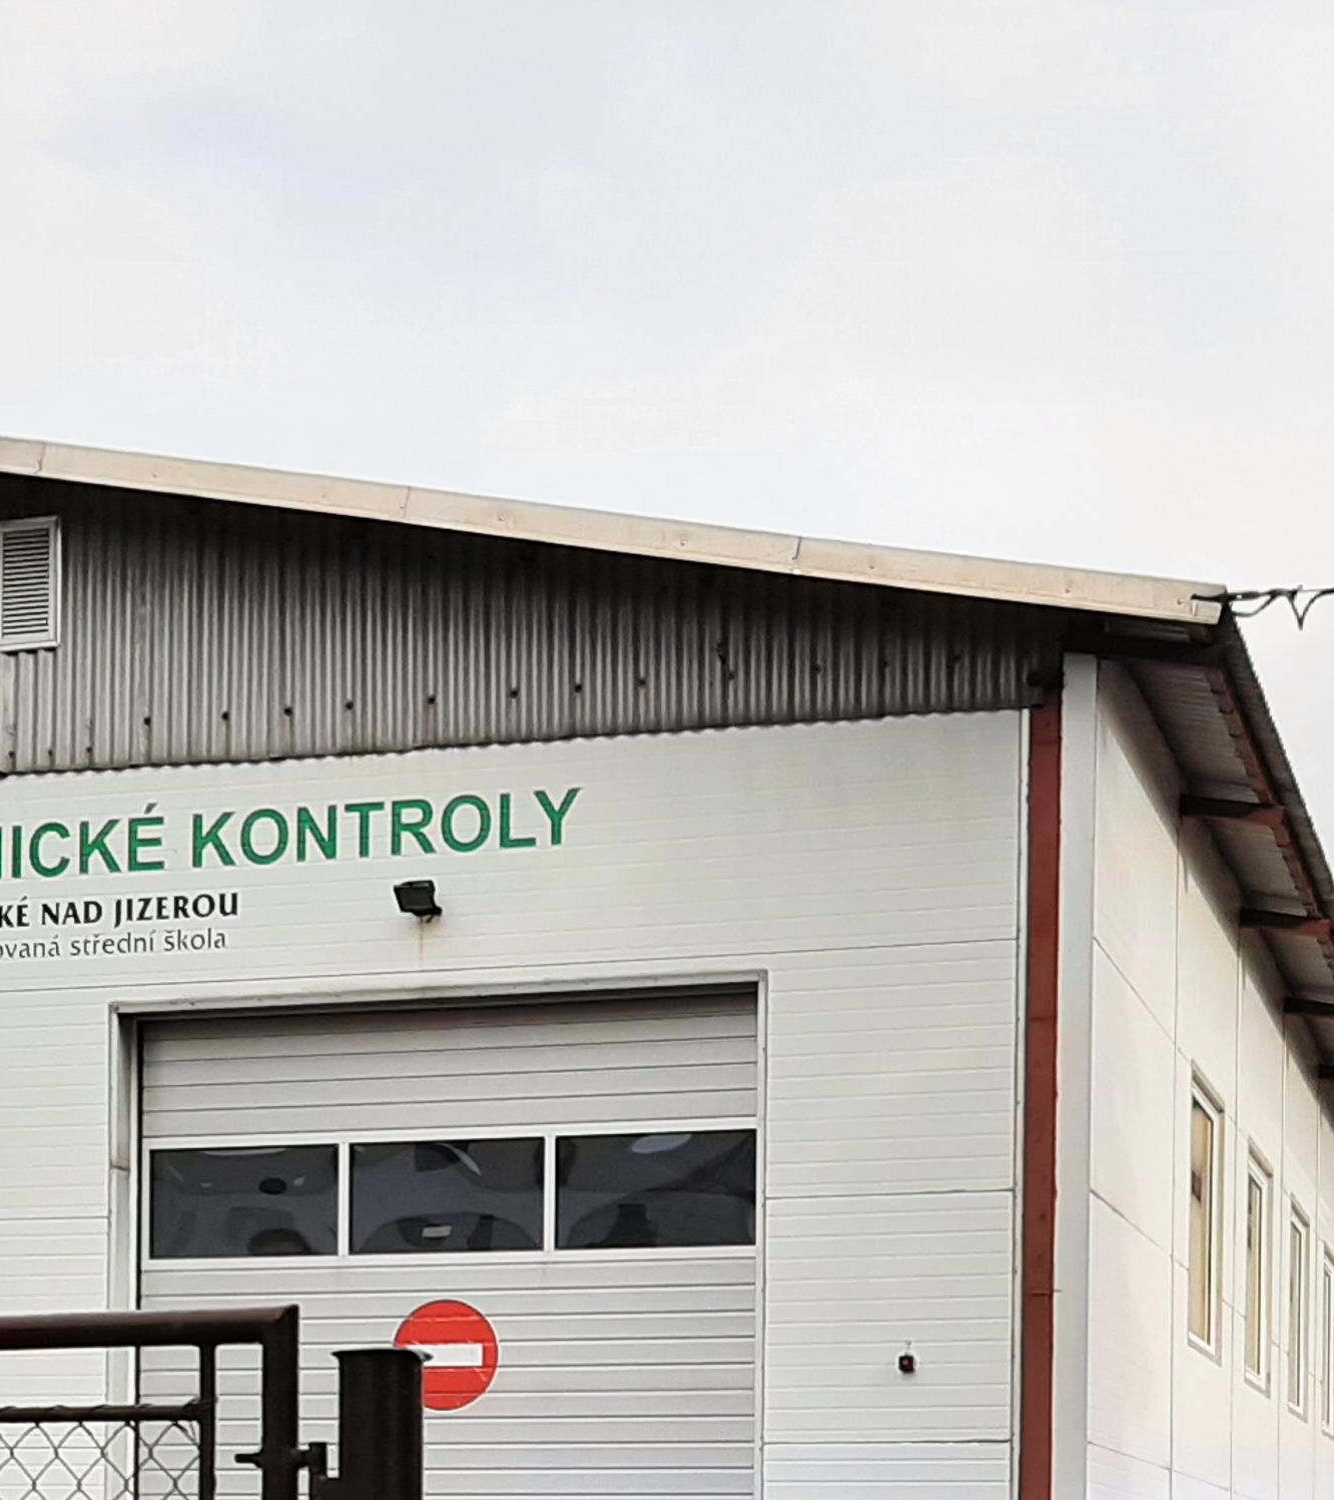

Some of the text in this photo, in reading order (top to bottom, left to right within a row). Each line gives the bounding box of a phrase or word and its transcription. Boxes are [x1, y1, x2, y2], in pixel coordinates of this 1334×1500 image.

[192, 788, 581, 869] KONTROLY
[41, 900, 104, 926] NAD
[113, 892, 240, 928] JIZEROU
[70, 930, 157, 957] střední
[164, 926, 228, 953] škola
